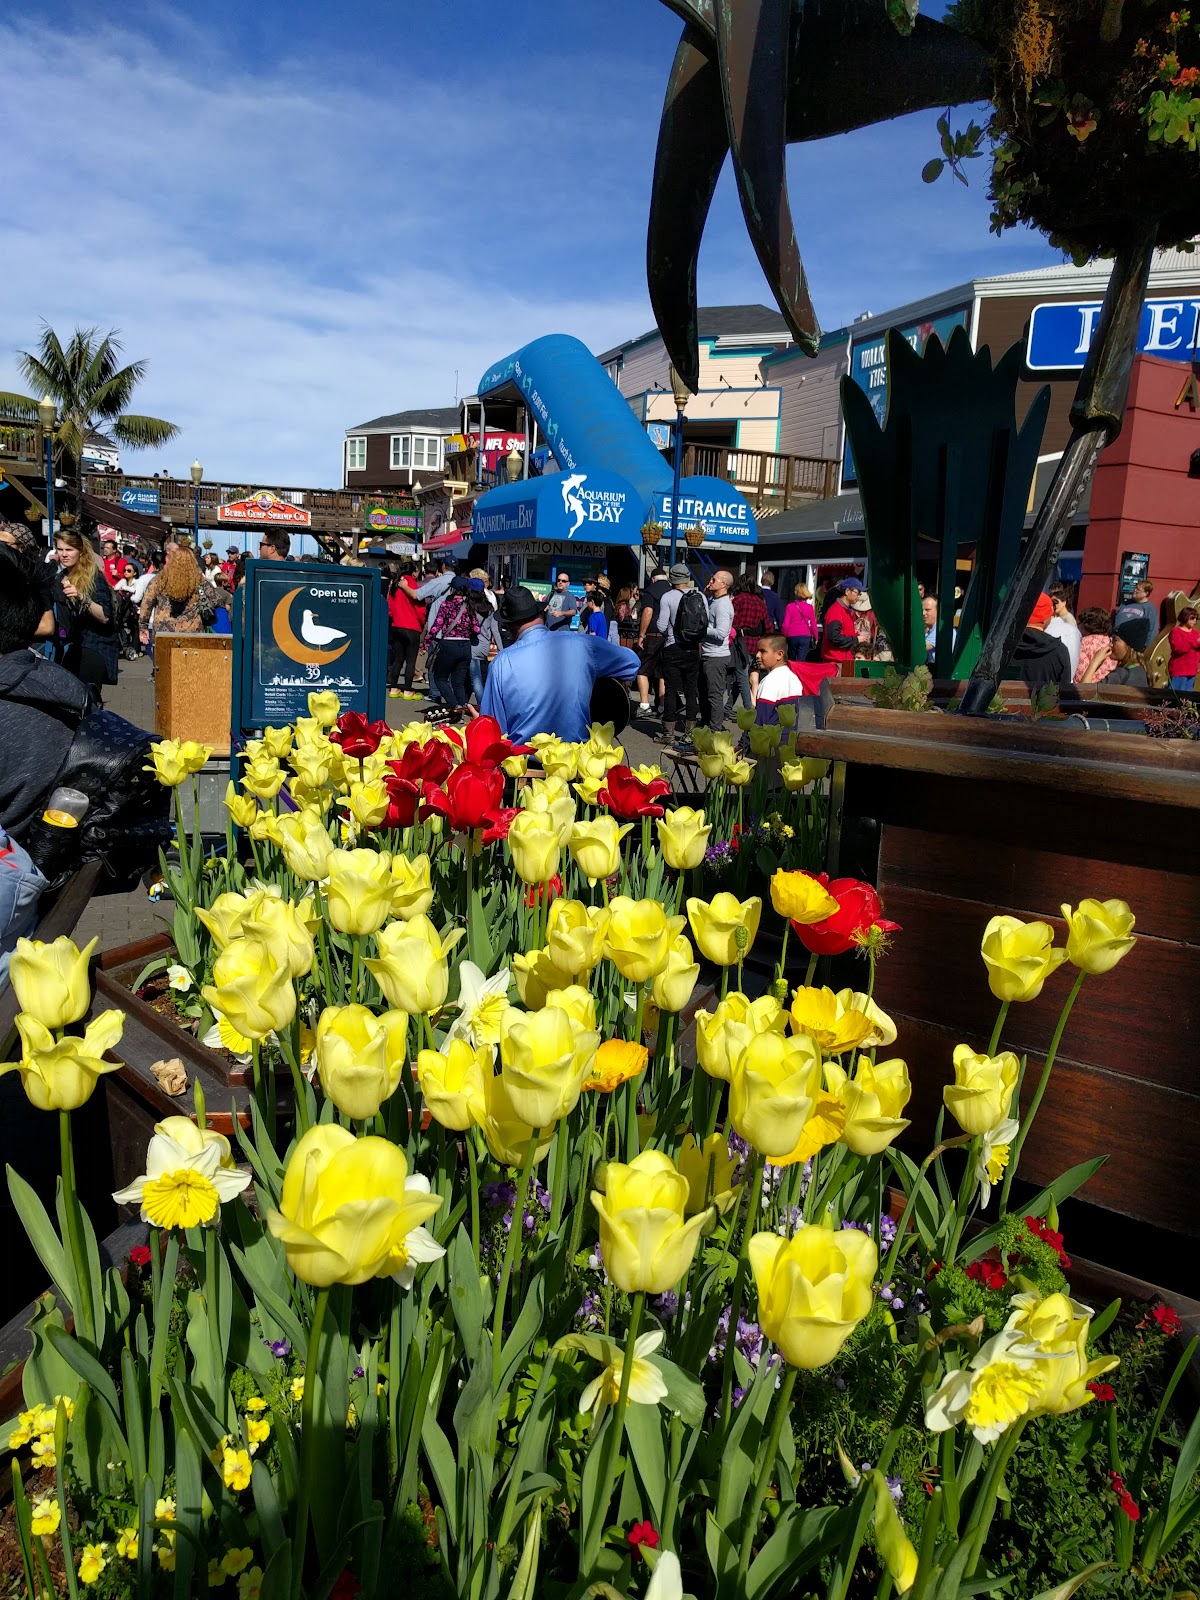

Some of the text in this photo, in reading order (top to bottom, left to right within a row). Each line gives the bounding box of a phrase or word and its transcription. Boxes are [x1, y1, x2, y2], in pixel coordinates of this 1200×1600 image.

[861, 344, 886, 369] WALK
[485, 438, 504, 451] NFL
[558, 438, 577, 470] Touch Pool
[576, 487, 626, 504] AQUARIUM
[224, 508, 247, 518] BUBBA
[247, 509, 266, 519] GUMP
[267, 511, 293, 521] SHRIMP
[588, 503, 625, 524] BAY
[662, 497, 747, 520] ENTRANCE
[475, 511, 507, 538] AQUARIUM
[518, 504, 534, 529] BAY
[658, 521, 698, 531] AQURIUM
[719, 526, 750, 536] THEATER
[572, 543, 605, 558] MAPS
[310, 587, 358, 599] Open Late
[305, 668, 321, 680] 39
